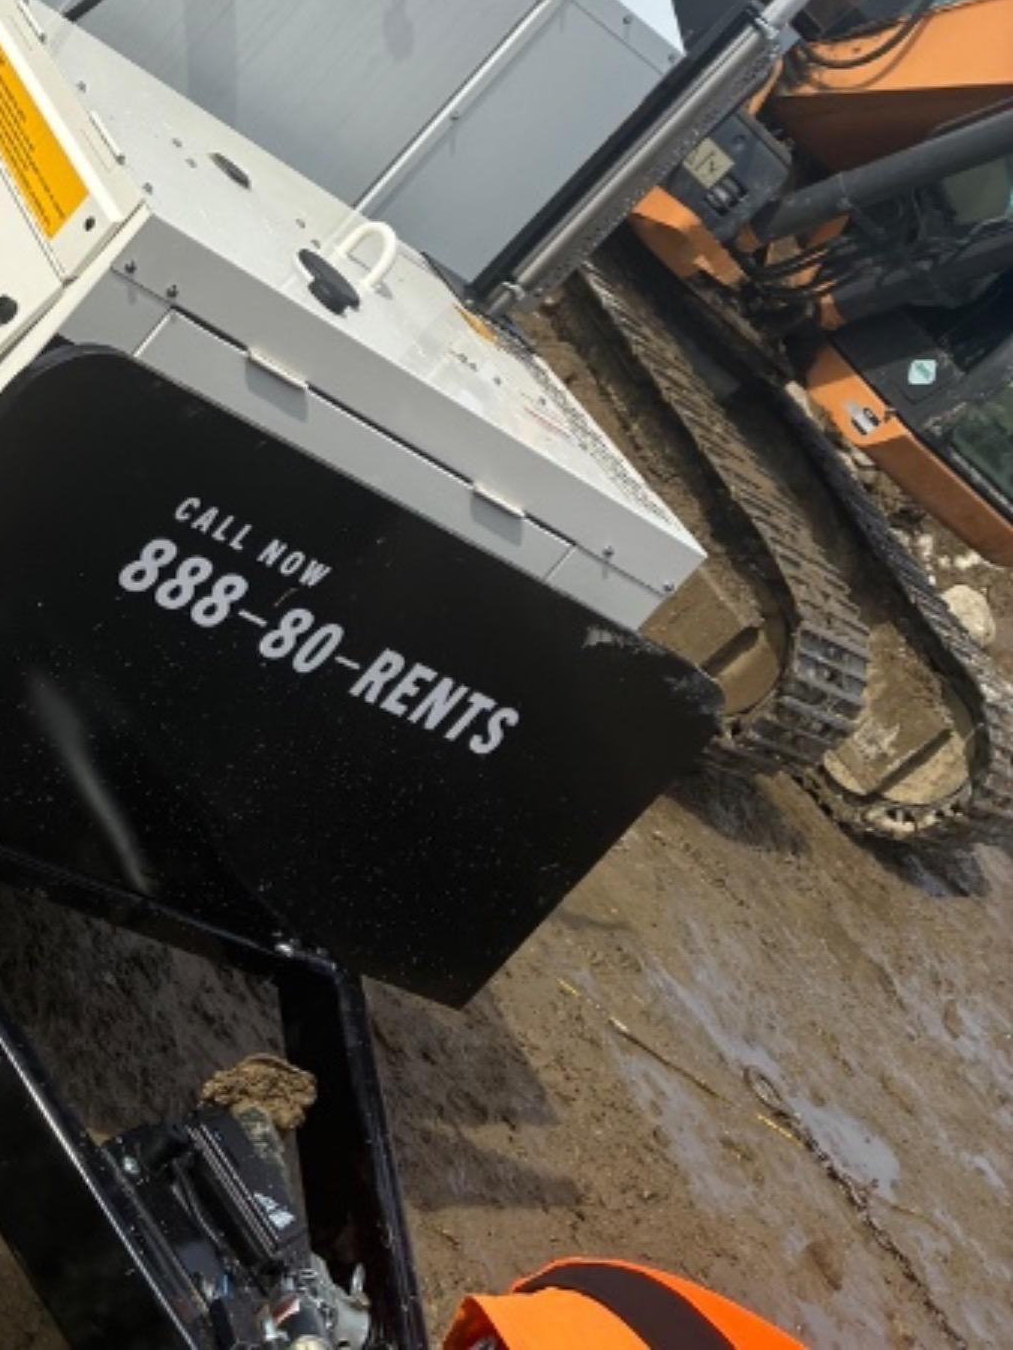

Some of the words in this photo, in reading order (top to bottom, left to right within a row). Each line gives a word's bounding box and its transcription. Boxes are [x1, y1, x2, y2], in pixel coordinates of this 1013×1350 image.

[174, 497, 253, 551] CALL
[256, 538, 332, 588] NOW
[118, 537, 520, 755] 888-80-RENTS
